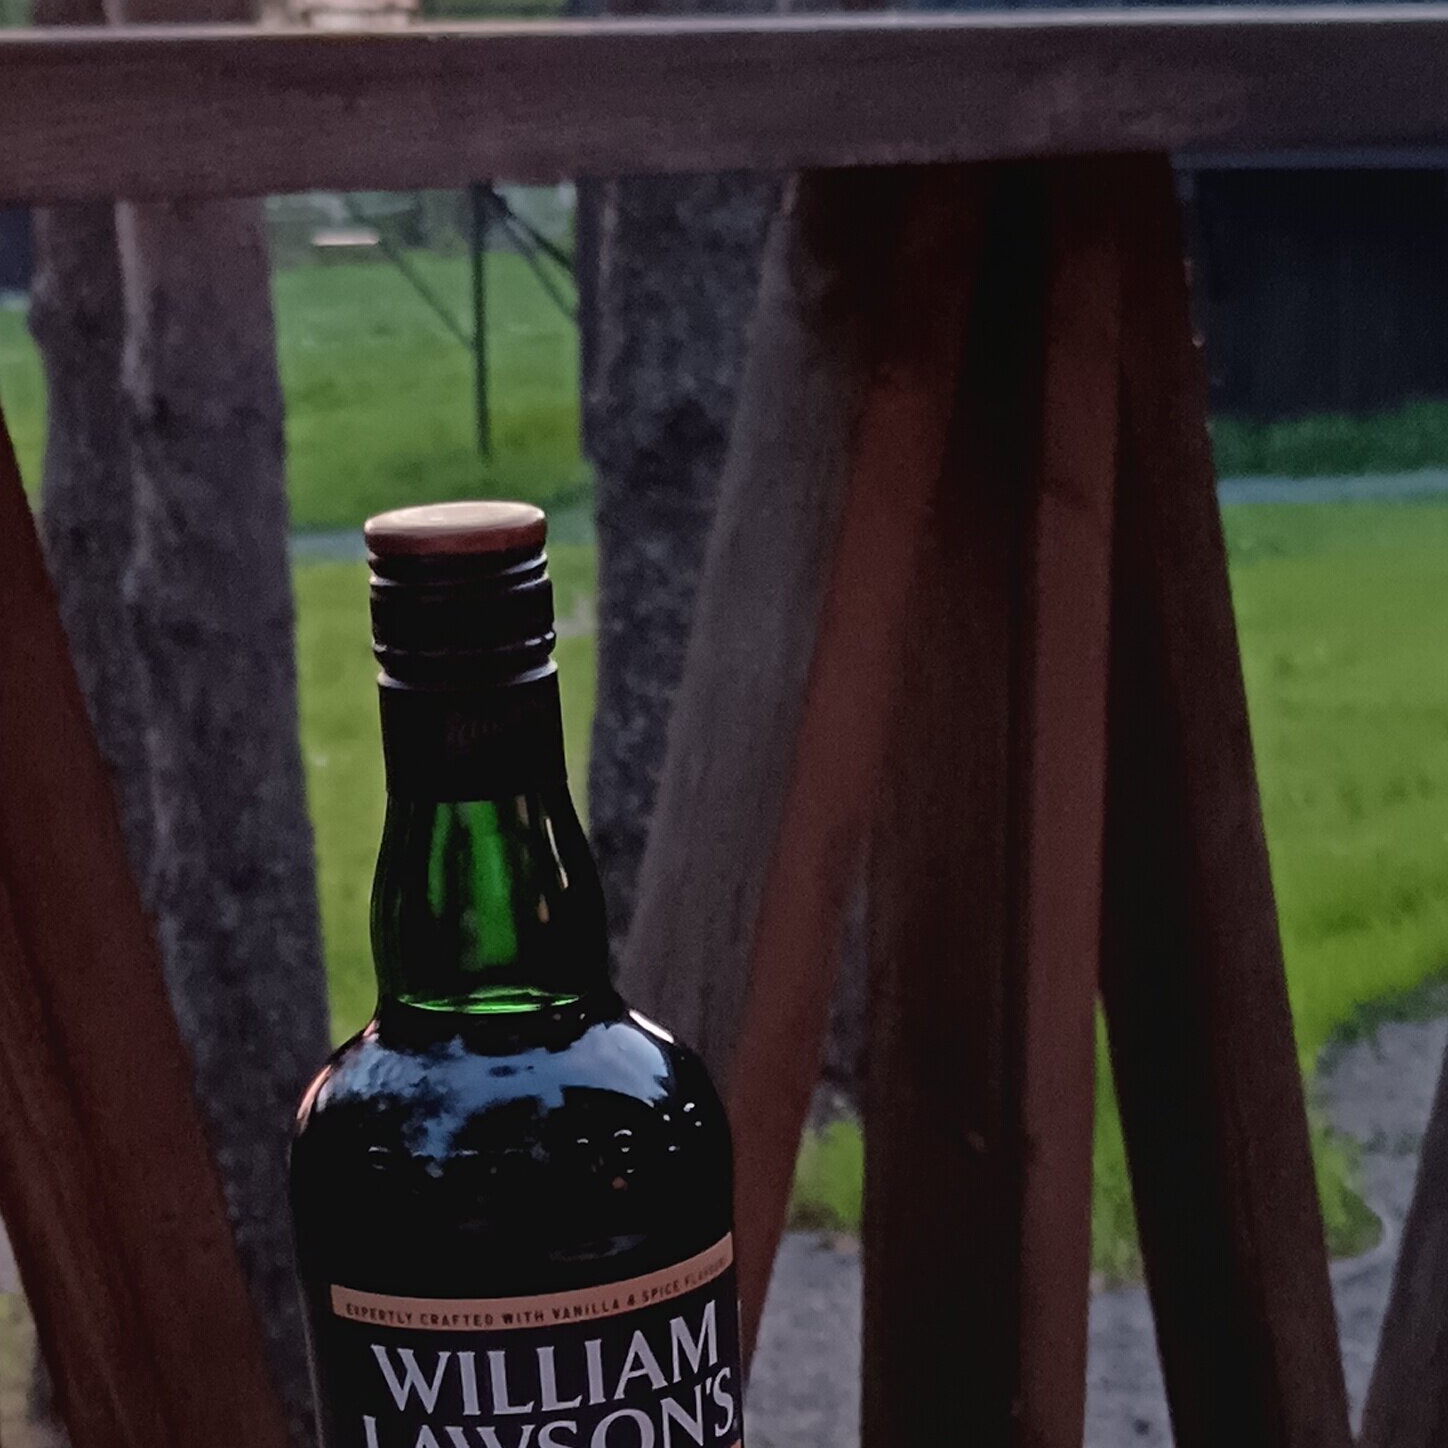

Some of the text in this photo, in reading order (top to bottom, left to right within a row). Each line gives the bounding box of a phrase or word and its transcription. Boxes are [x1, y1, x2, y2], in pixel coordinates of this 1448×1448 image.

[346, 1303, 411, 1324] EXPERTLY
[420, 1313, 493, 1327] CRAFTED
[502, 1311, 544, 1325] WITH
[552, 1299, 619, 1319] VANILLA
[642, 1280, 680, 1303] SPICE
[370, 1299, 718, 1416] WILLIAM
